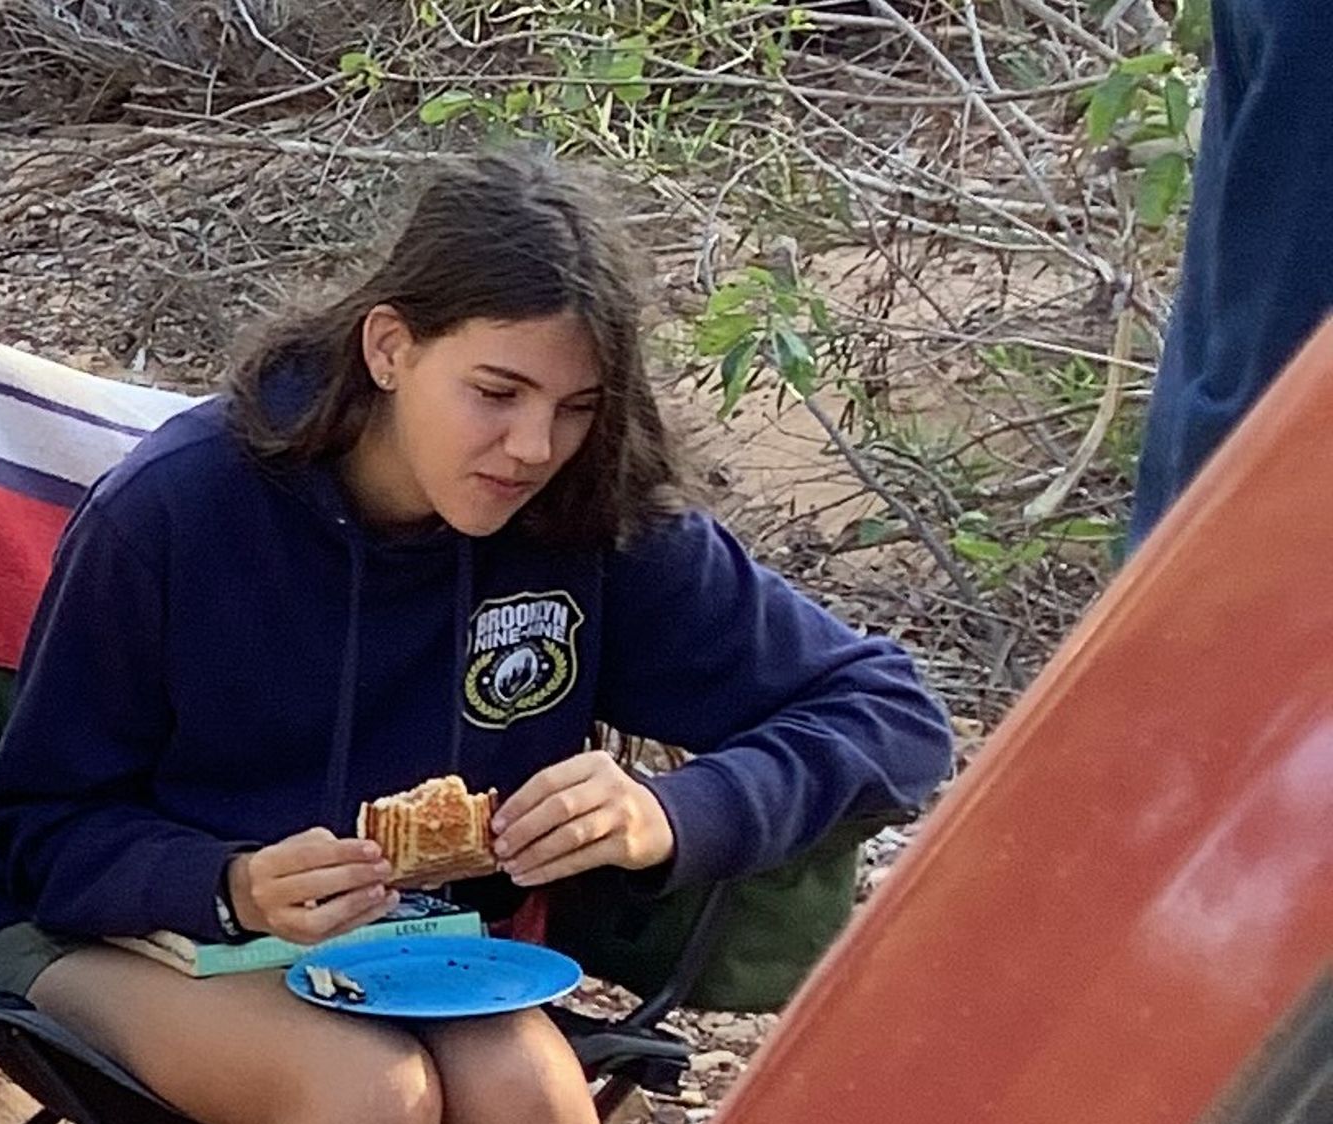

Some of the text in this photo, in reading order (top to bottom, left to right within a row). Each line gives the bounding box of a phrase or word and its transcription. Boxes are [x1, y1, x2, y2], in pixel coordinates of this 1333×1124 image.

[476, 600, 568, 634] BROOKLYN
[474, 627, 521, 654] NINE
[395, 922, 438, 936] LESLEY
